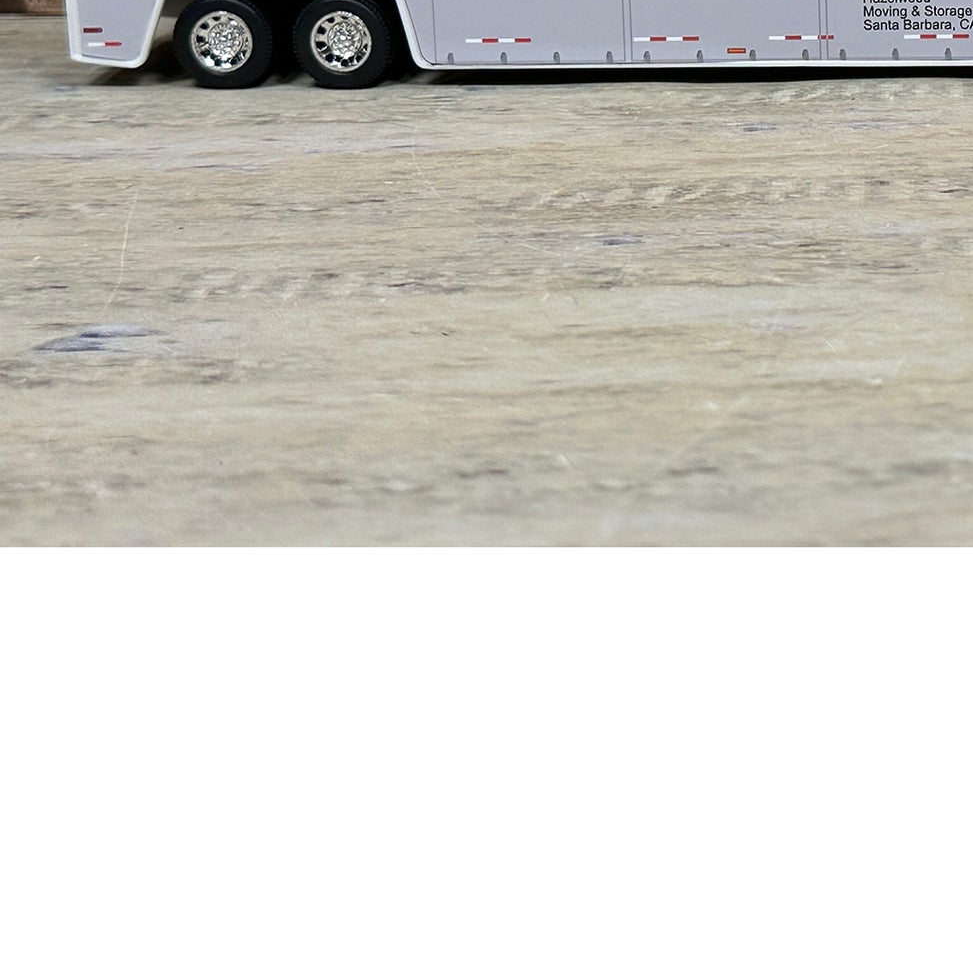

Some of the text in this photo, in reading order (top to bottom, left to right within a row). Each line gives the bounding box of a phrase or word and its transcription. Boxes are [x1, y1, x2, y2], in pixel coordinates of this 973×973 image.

[863, 5, 973, 19] Moving & Storage
[863, 19, 900, 31] Santa
[903, 18, 956, 31] Barbara,
